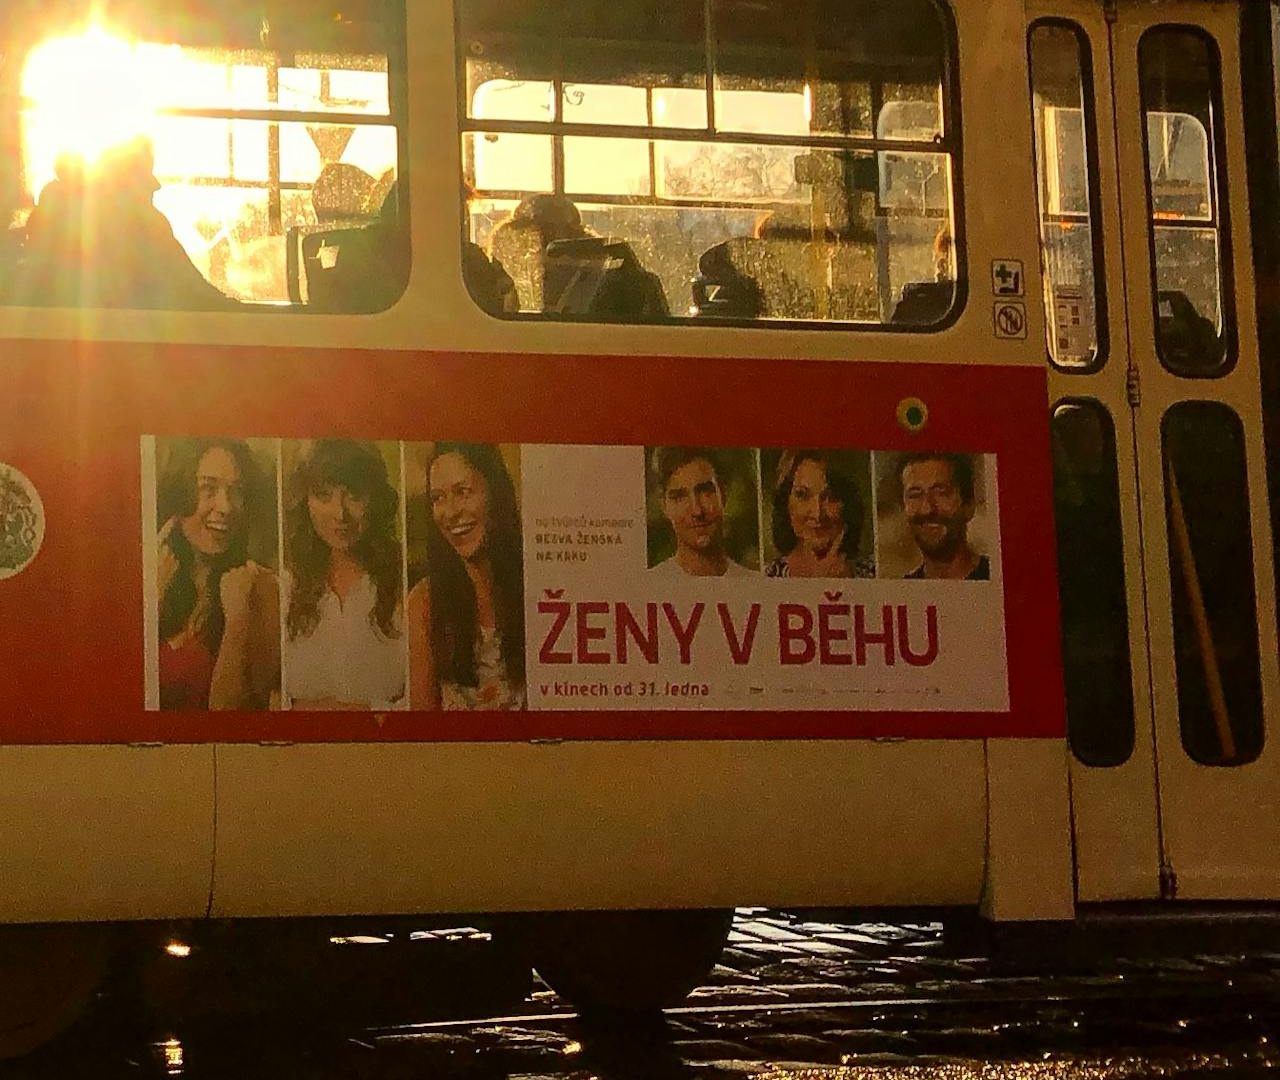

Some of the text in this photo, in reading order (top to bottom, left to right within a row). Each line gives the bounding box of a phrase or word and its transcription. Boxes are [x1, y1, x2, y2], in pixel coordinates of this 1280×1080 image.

[537, 588, 939, 667] ŽENY V BĚHU
[540, 684, 549, 696] v
[554, 681, 608, 697] kinech
[613, 682, 632, 697] od
[638, 682, 661, 697] 31.
[665, 682, 710, 697] ledna
